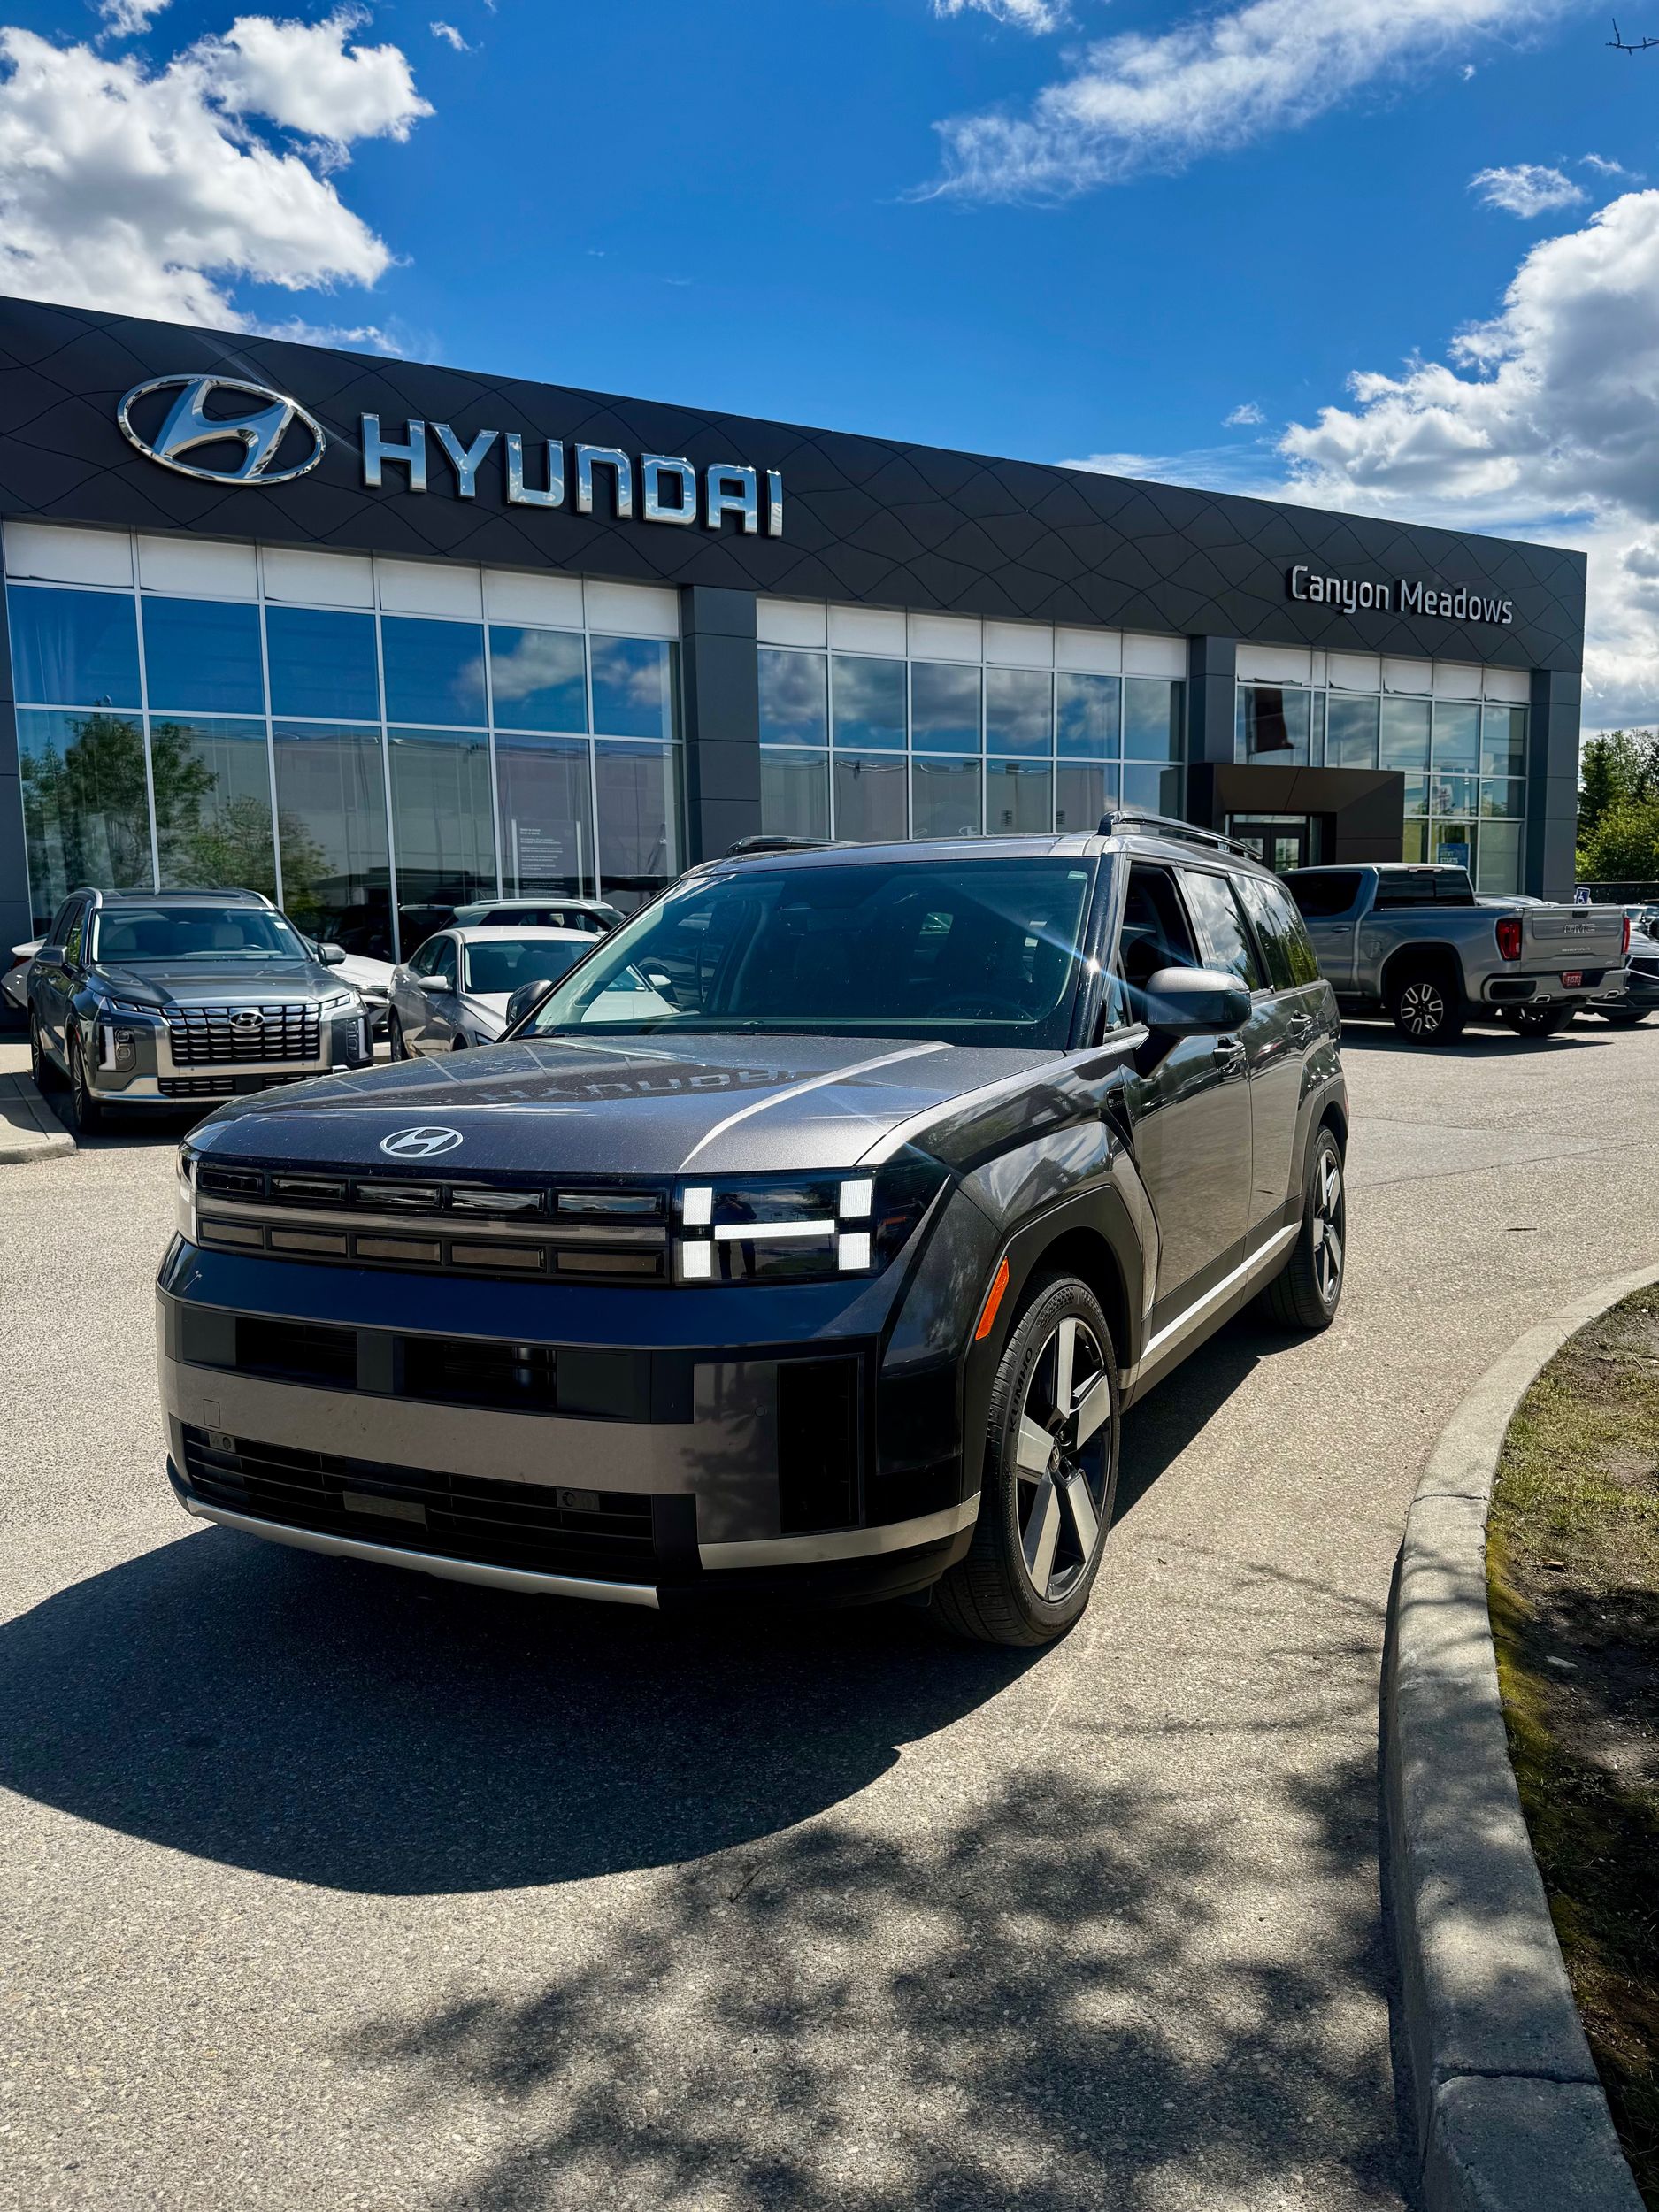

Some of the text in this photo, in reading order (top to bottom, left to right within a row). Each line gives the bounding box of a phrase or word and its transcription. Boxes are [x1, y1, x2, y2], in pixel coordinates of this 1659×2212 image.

[362, 412, 783, 536] HYUNDAI
[1292, 565, 1514, 624] Canyon Meadows
[1564, 924, 1595, 933] GMC
[1010, 1347, 1033, 1432] KUMHO
